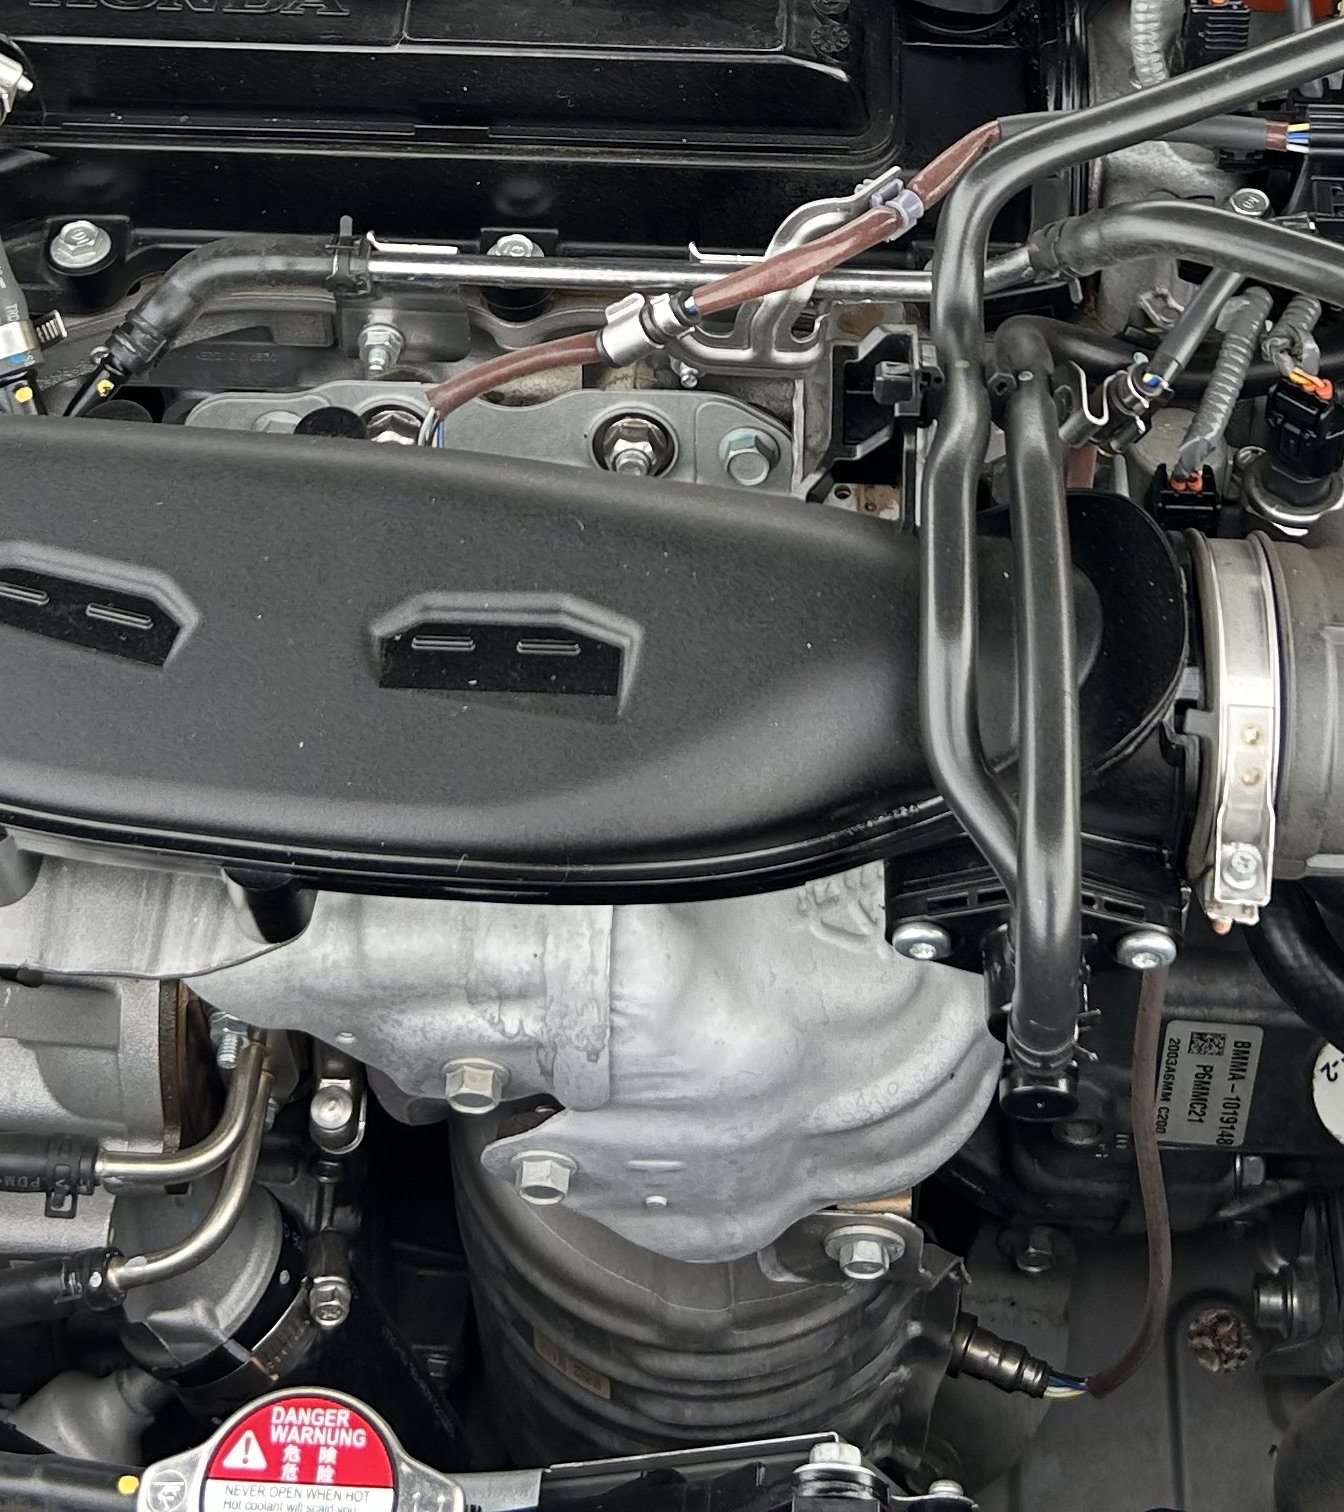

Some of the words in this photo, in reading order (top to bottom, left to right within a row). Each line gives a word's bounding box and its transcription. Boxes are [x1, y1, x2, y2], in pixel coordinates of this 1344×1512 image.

[271, 1405, 351, 1427] DANGER
[270, 1426, 367, 1448] WARNUNG
[225, 1484, 265, 1497] NEVER
[269, 1486, 303, 1499] OPEN
[306, 1488, 342, 1501] WHEN
[345, 1490, 370, 1502] HOT
[223, 1499, 243, 1510] Hot
[244, 1501, 283, 1512] coolant
